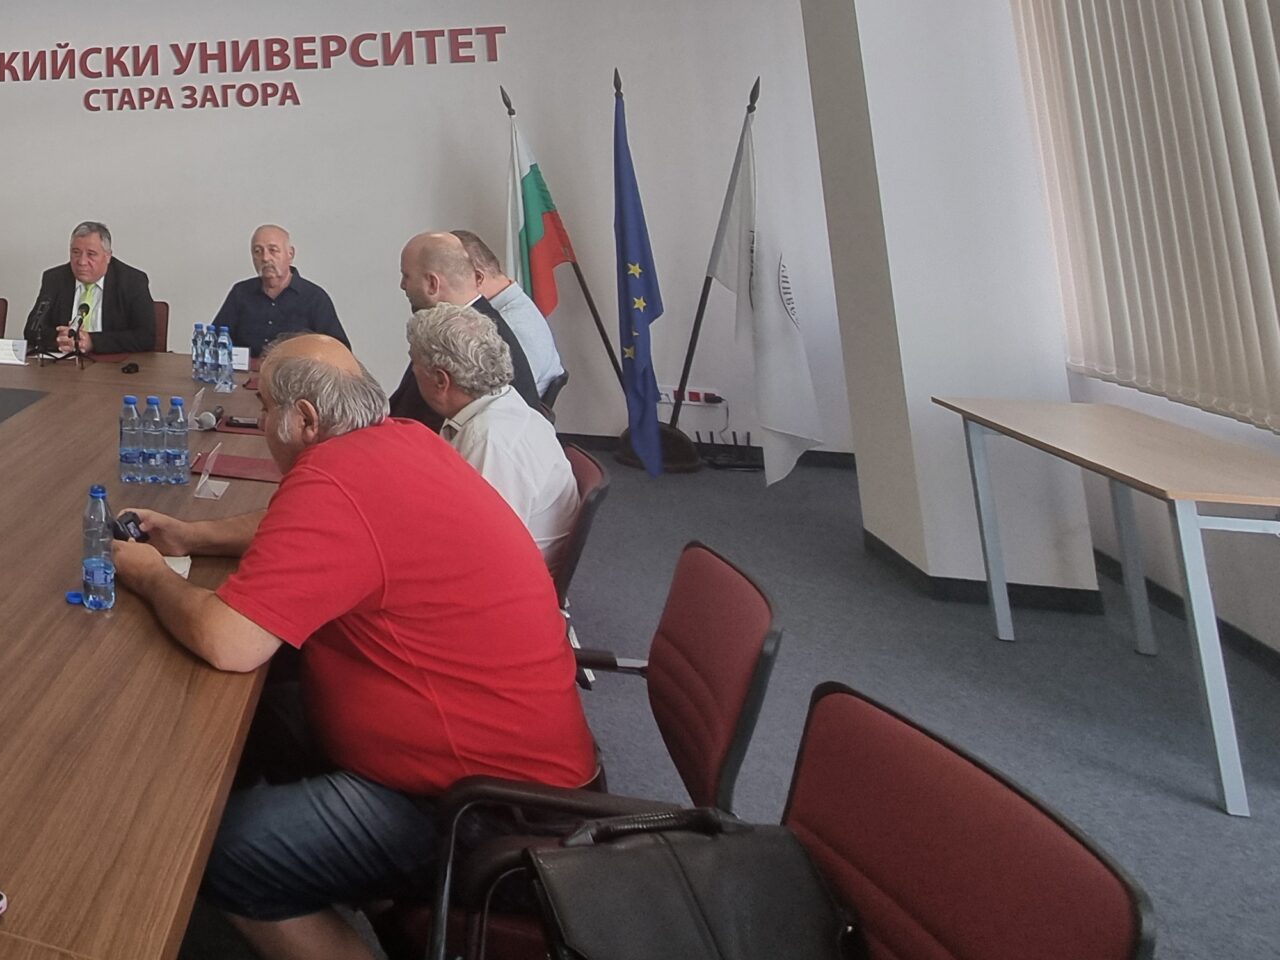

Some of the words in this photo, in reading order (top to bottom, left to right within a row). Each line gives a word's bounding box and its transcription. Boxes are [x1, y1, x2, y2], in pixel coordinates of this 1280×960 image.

[170, 25, 506, 75] УНИВЕРСИТЕТ
[83, 85, 175, 111] СТАРА
[181, 81, 300, 109] ЗАГОРА
